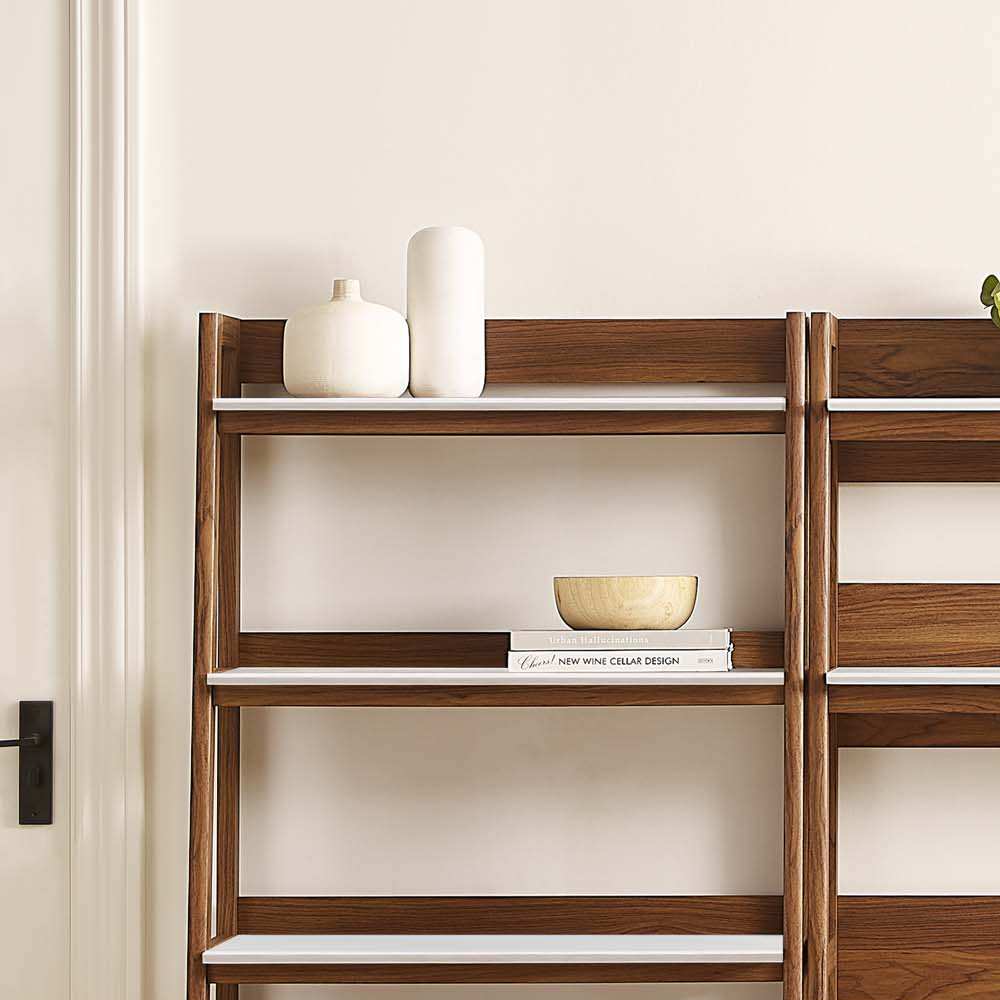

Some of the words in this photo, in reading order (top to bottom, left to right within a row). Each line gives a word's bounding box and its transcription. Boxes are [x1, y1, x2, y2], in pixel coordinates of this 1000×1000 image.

[559, 657, 580, 666] NEW
[582, 657, 607, 666] WINE
[609, 657, 642, 666] CELLAR
[645, 657, 680, 666] DESIGN
